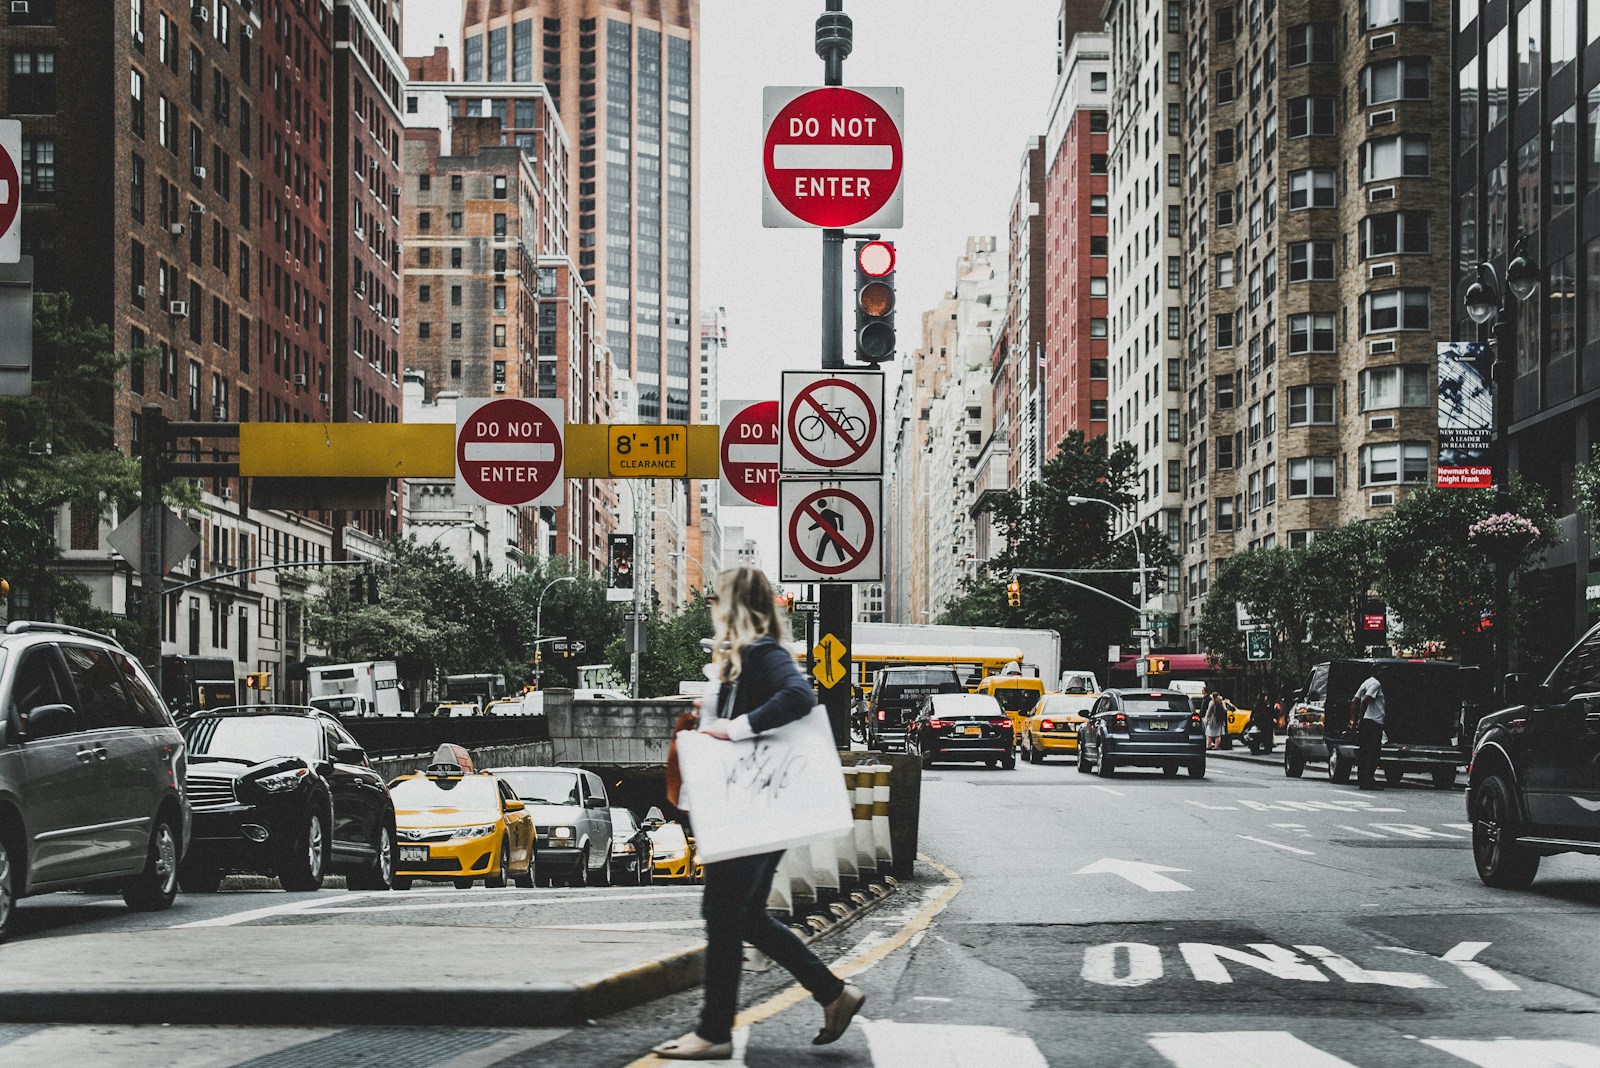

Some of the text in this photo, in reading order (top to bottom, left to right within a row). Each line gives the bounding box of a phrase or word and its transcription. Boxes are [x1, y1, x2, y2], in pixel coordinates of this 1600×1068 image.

[789, 117, 876, 137] DO NOT
[795, 177, 871, 197] ENTER
[476, 422, 543, 438] DO NOT
[740, 423, 763, 439] DO
[619, 460, 676, 469] CLEARANCE
[480, 466, 538, 482] ENTER
[744, 468, 778, 484] ENT
[1437, 475, 1480, 484] Knight Frank
[1080, 941, 1521, 992] ONLY
